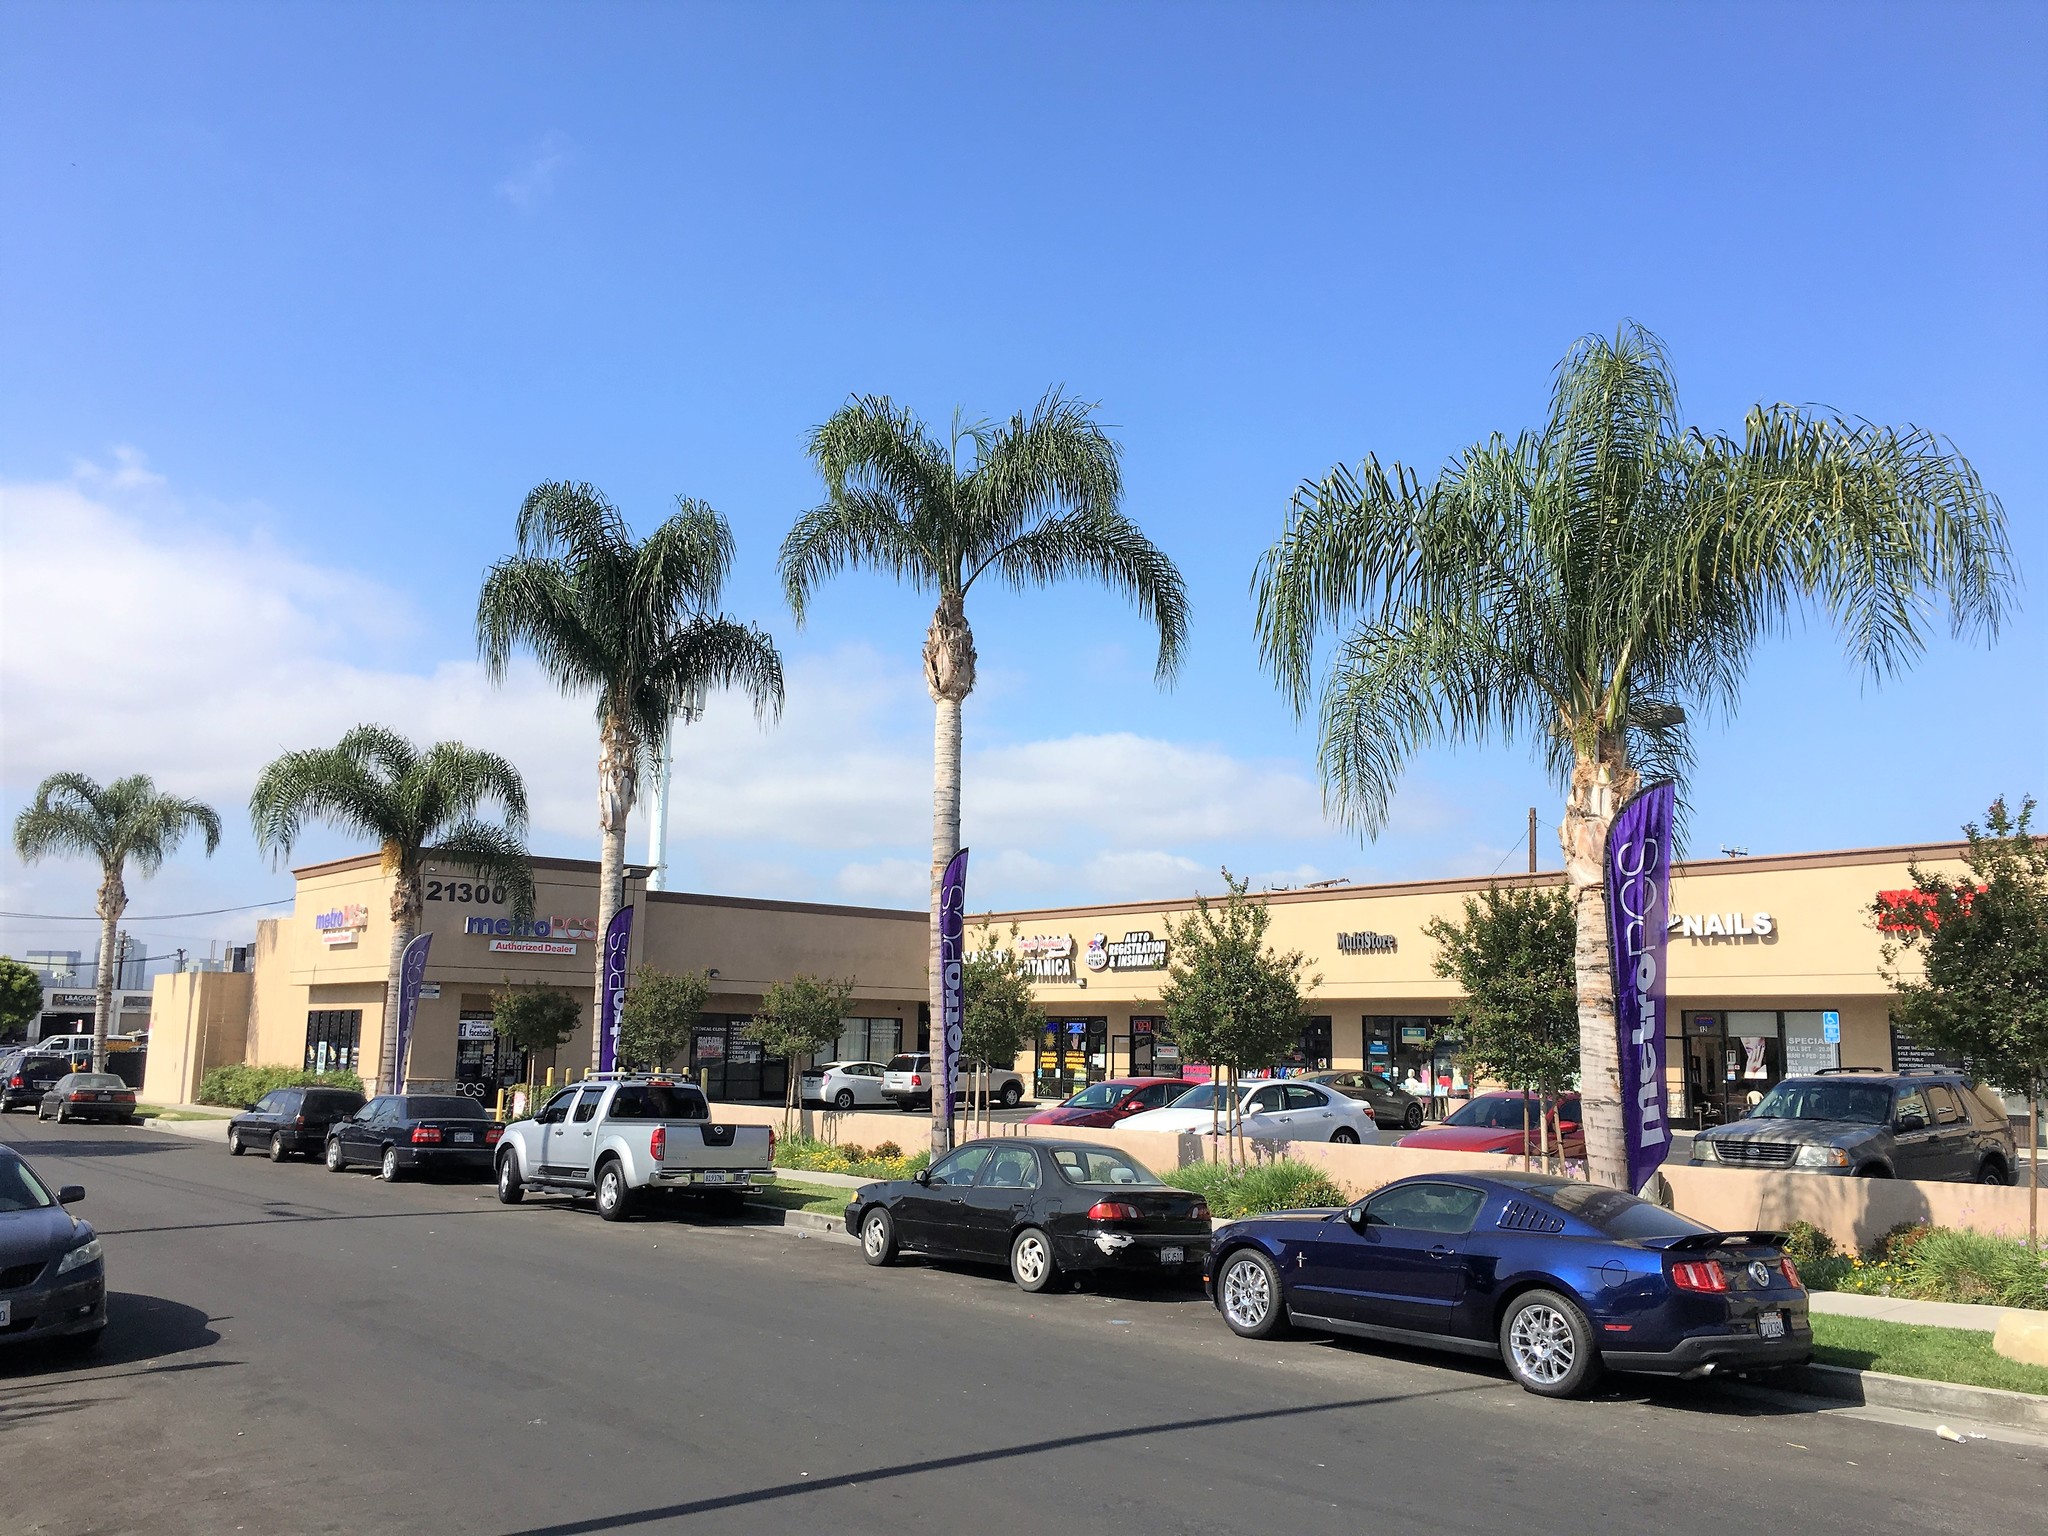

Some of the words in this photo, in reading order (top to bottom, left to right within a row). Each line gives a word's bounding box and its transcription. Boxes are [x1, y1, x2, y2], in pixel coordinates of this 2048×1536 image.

[426, 881, 506, 904] 21300
[465, 916, 599, 940] metroPCS
[1684, 912, 1772, 936] NAILS
[1125, 932, 1150, 942] AUTO
[1337, 931, 1393, 949] MultiStore
[495, 941, 544, 952] Authorized
[545, 944, 573, 953] Dealer
[1109, 941, 1166, 955] REGISTRATION
[1108, 956, 1116, 967] &
[1118, 953, 1164, 966] INSURANCE
[469, 1028, 492, 1037] facebook
